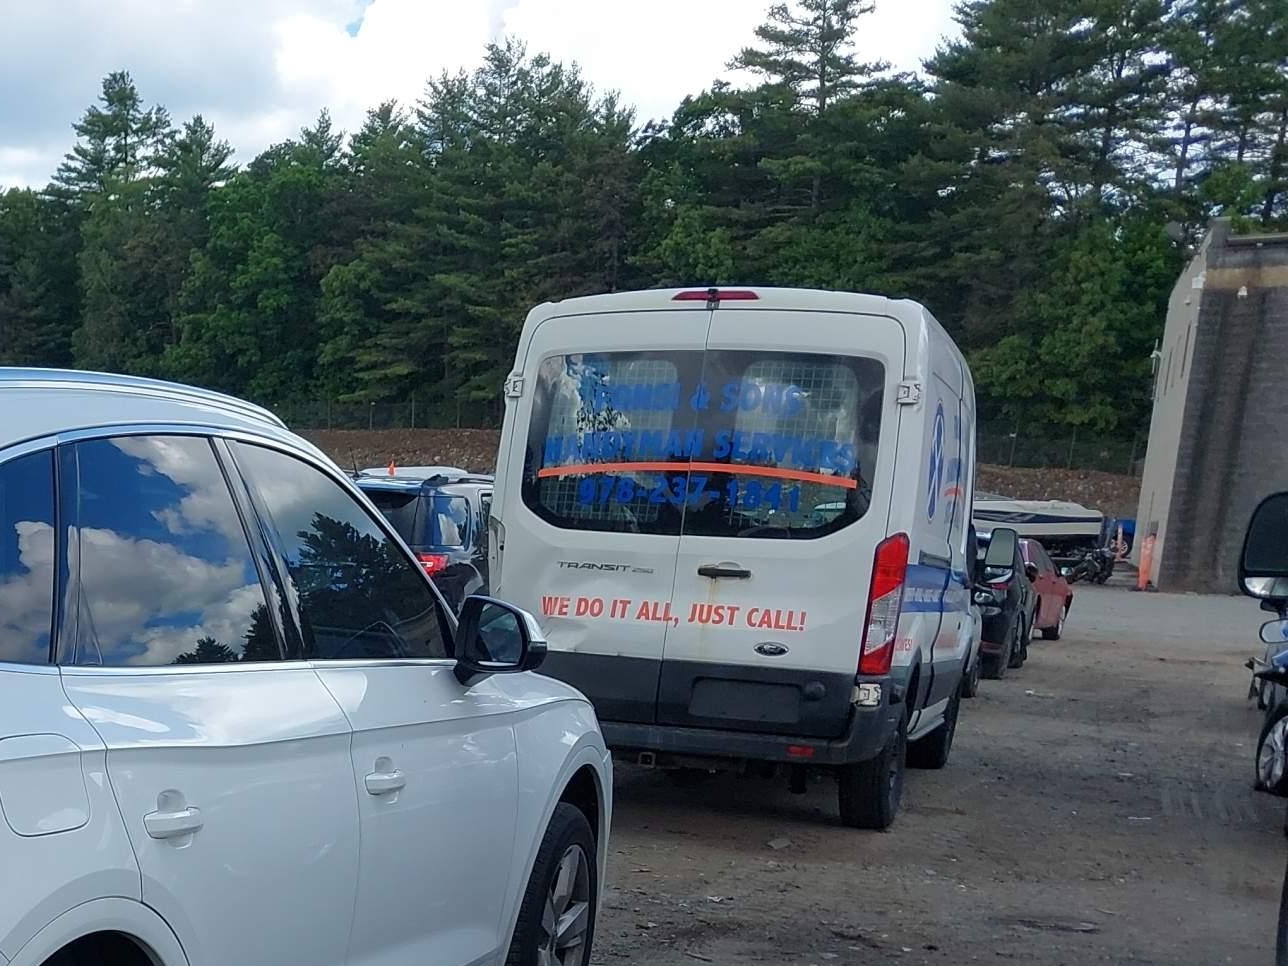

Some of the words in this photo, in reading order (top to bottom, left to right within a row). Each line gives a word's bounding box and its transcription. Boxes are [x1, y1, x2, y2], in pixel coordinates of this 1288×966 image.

[543, 427, 705, 465] HANDYMAN
[578, 476, 800, 514] 978-237-1841
[557, 560, 631, 573] TRANSIT
[542, 596, 569, 617] WE
[575, 597, 604, 618] DO
[610, 599, 631, 619] IT
[636, 601, 679, 628] ALL,
[688, 604, 740, 626] JUST
[747, 608, 807, 632] CALL!
